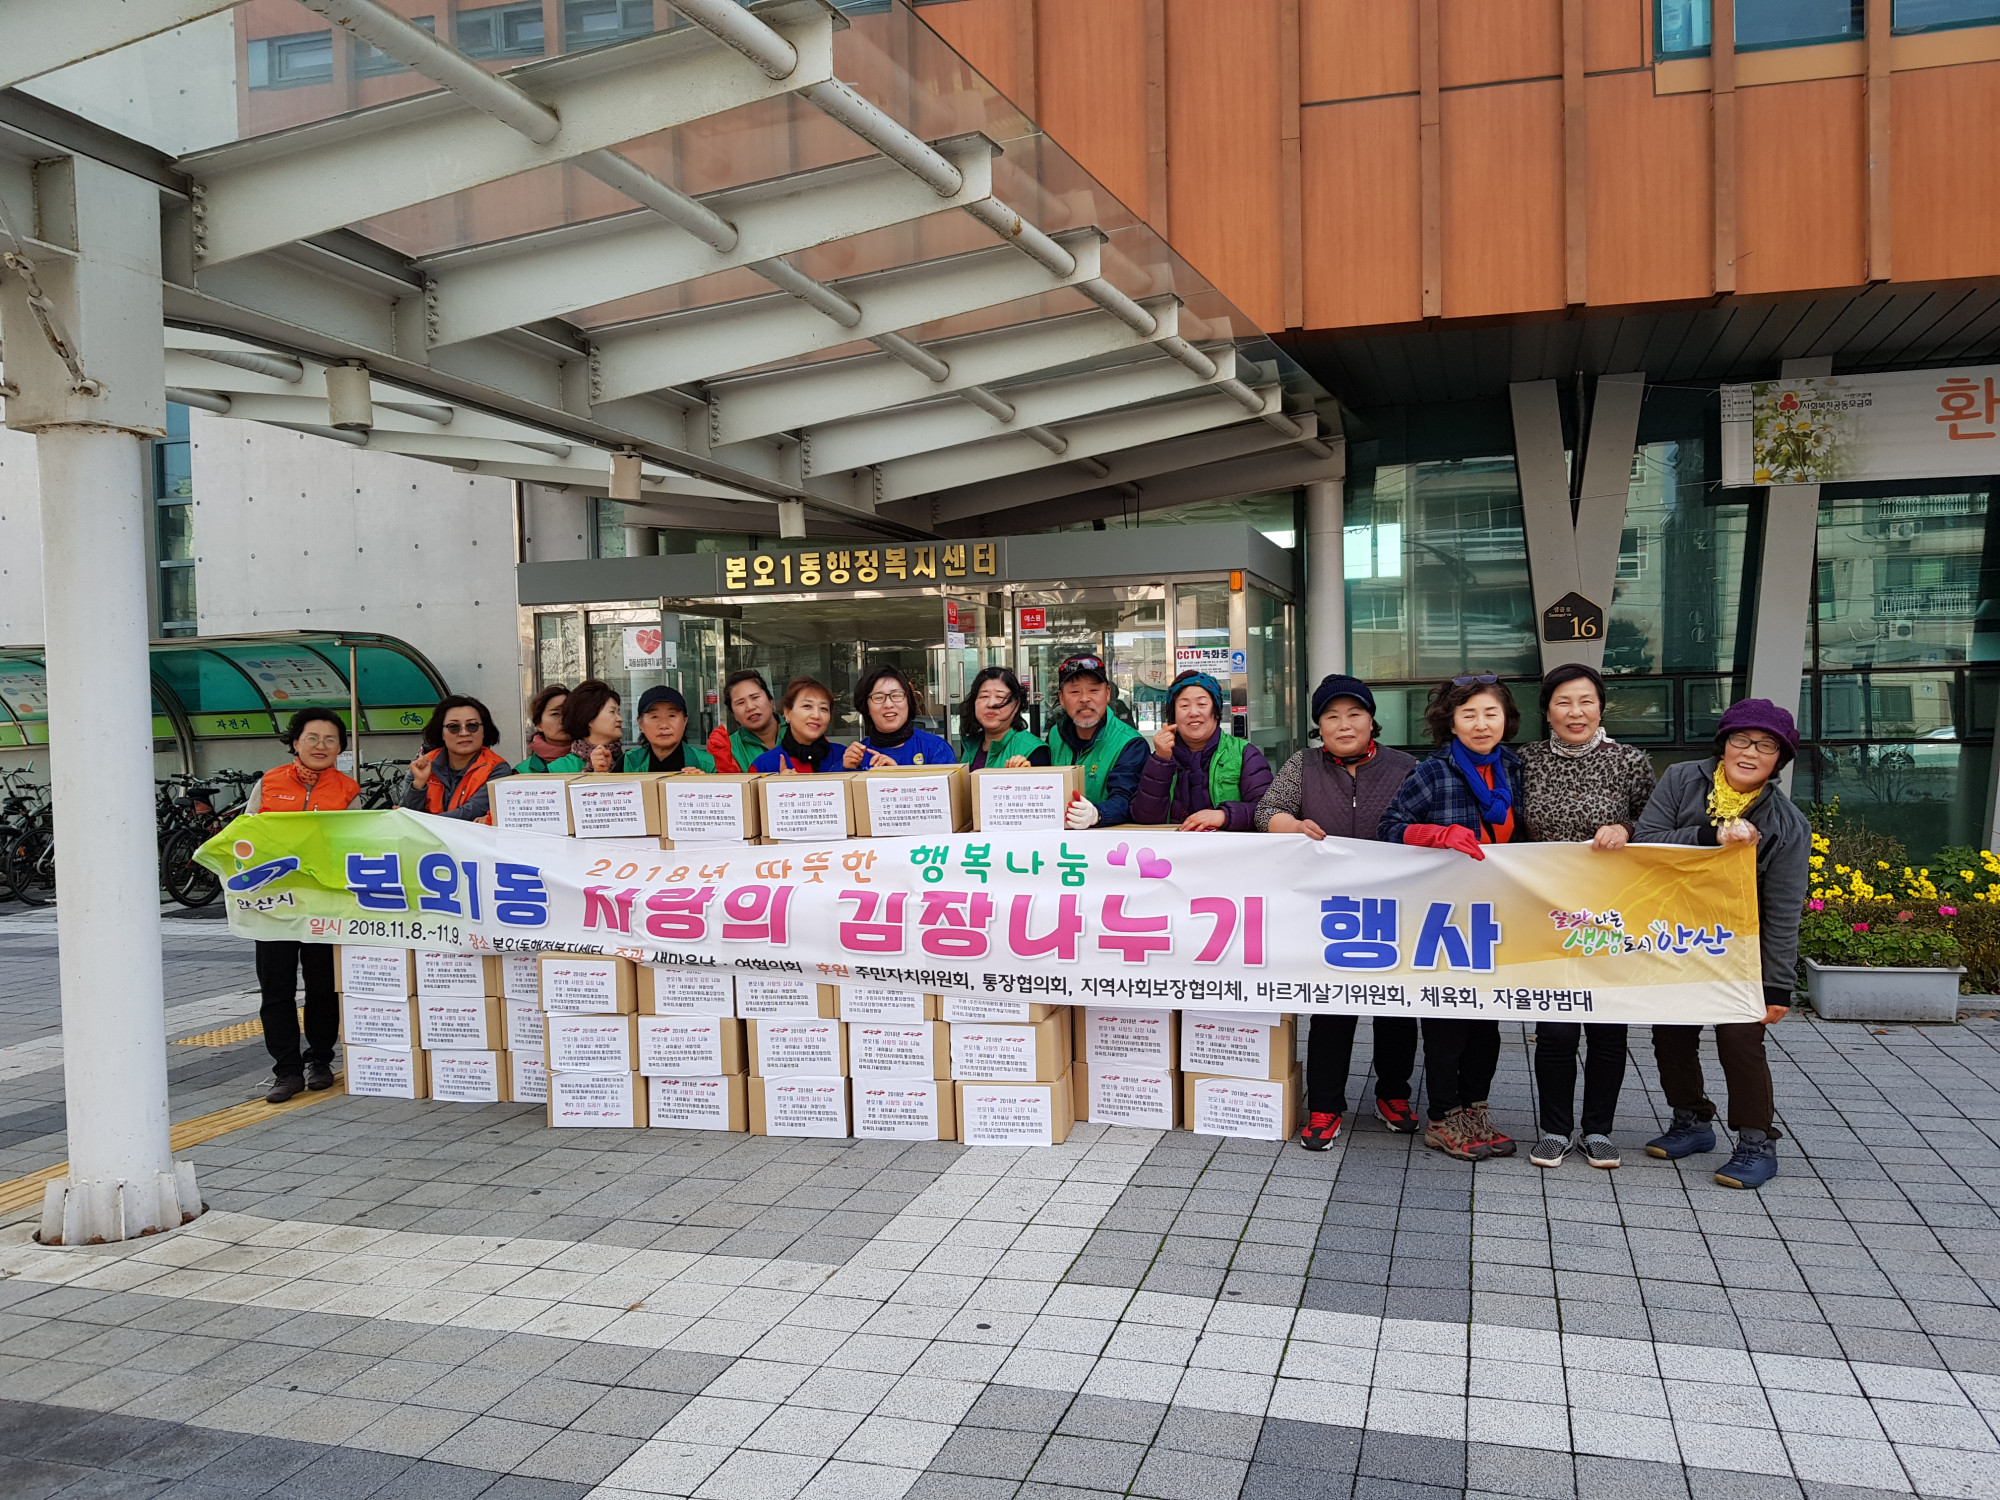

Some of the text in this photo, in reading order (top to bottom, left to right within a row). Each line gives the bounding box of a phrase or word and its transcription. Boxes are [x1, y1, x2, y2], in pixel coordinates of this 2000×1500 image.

[1802, 399, 1873, 410] 사회복지공동모금회
[1935, 377, 2000, 440] 환
[726, 543, 996, 590] 본오1동행정복지센터
[1024, 614, 1041, 622] 에스원
[1570, 616, 1597, 638] 16
[216, 718, 250, 730] 자전거
[585, 859, 730, 884] 2018년
[756, 850, 877, 884] 따뜻한
[237, 892, 294, 911] 안산시
[582, 885, 795, 944] 사랑의
[839, 889, 1264, 966] 김장나누기
[1320, 895, 1500, 970] 행사
[309, 918, 342, 935] 일시
[468, 933, 490, 950] 장소
[816, 963, 850, 978] 후원
[855, 965, 975, 991] 주민자치위원회,
[982, 973, 1072, 998] 통장협의회,
[1081, 977, 1248, 1003] 지역사회보장협의체,
[1257, 982, 1411, 1008] 바르게살기위원회,
[1420, 987, 1484, 1010] 체육회,
[1493, 987, 1594, 1012] 자율방범대
